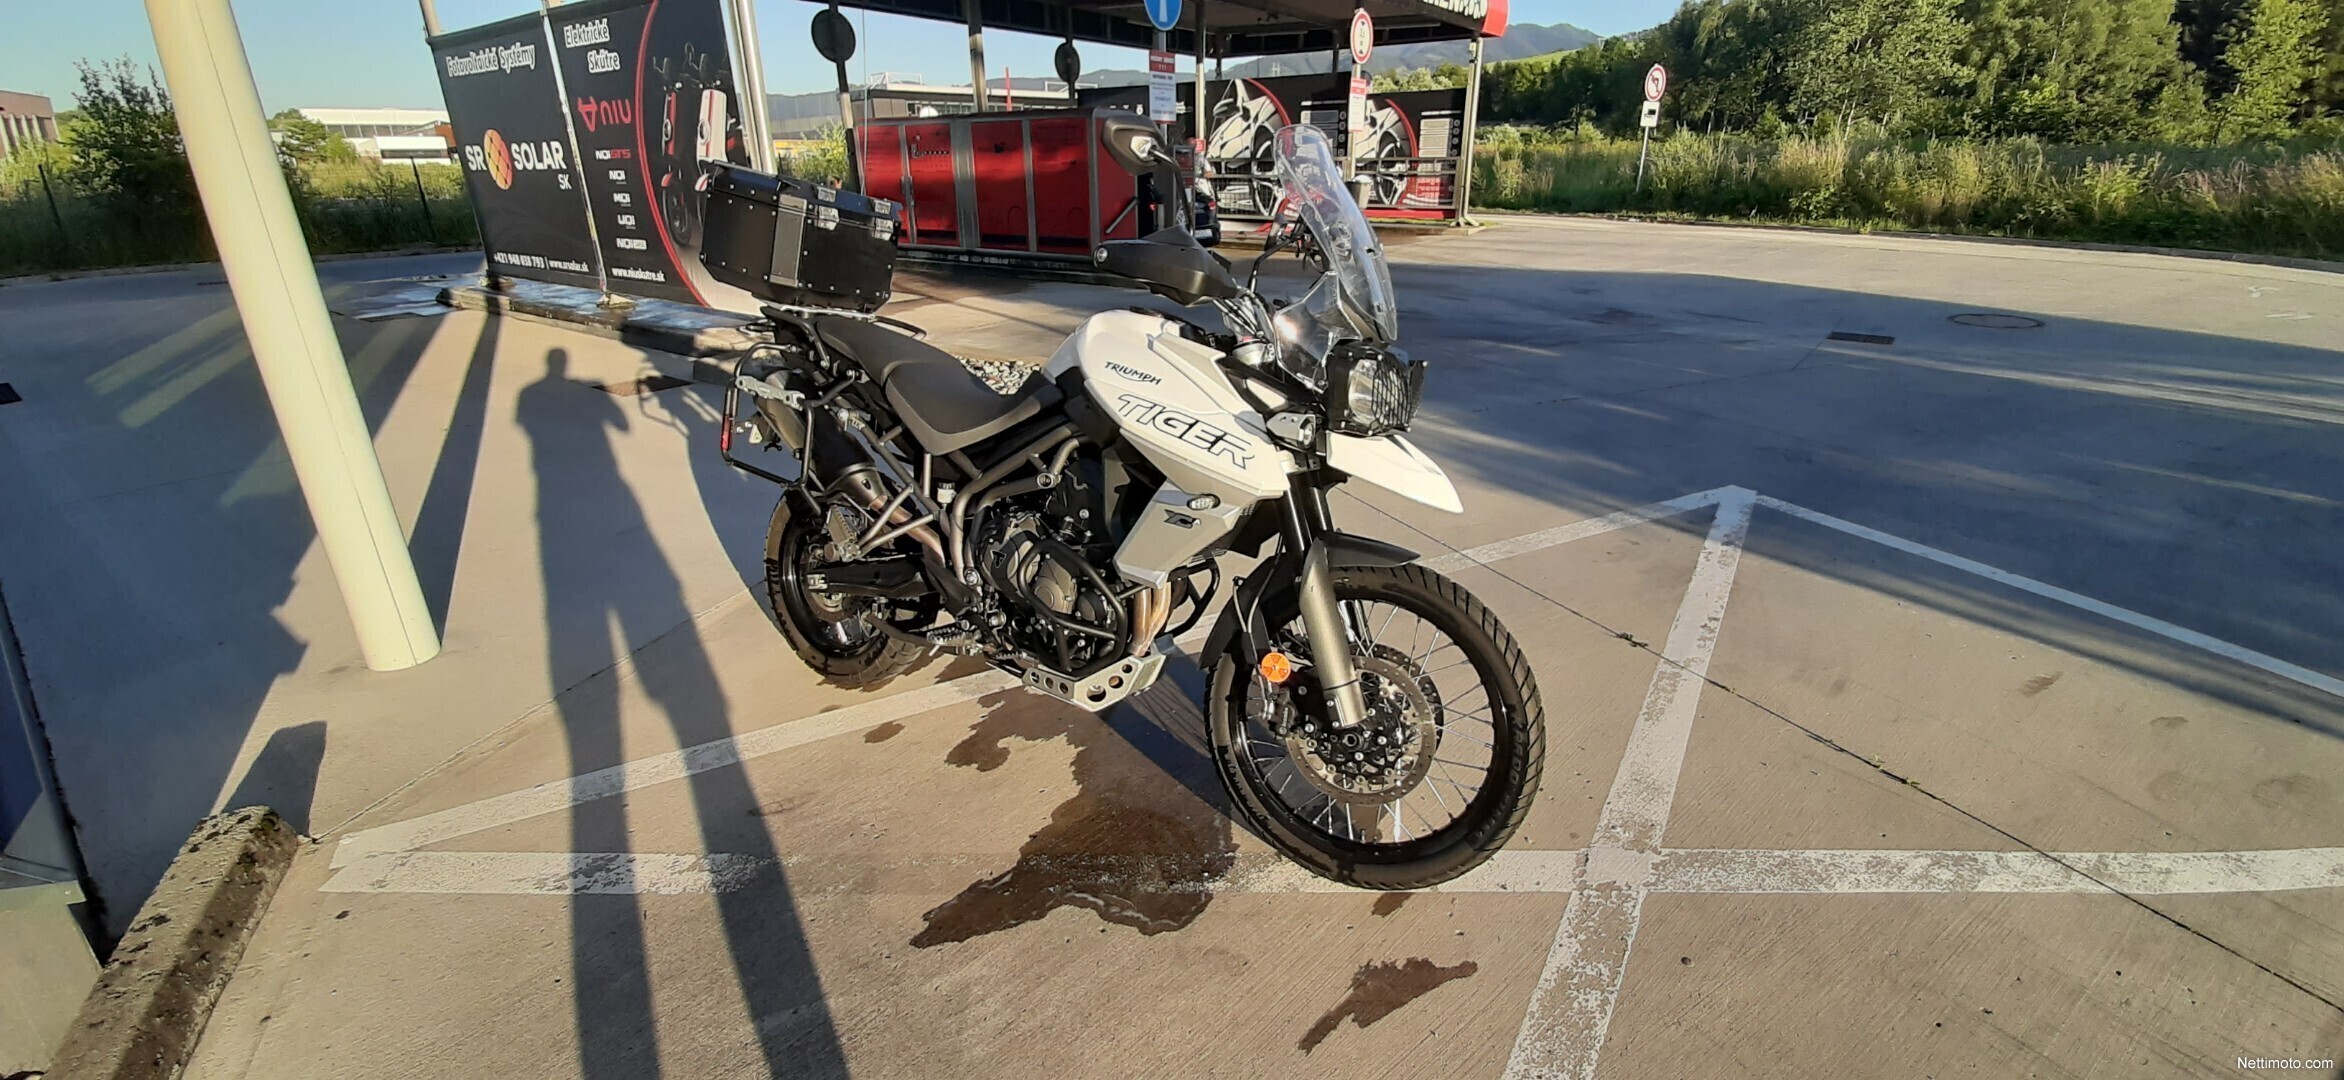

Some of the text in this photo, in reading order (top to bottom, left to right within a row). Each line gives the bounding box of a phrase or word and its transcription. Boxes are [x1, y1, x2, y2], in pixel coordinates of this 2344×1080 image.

[465, 141, 567, 171] SR SOLAR
[558, 174, 572, 190] SK
[1104, 361, 1162, 386] TRIUMPH
[1118, 394, 1255, 470] TIGER
